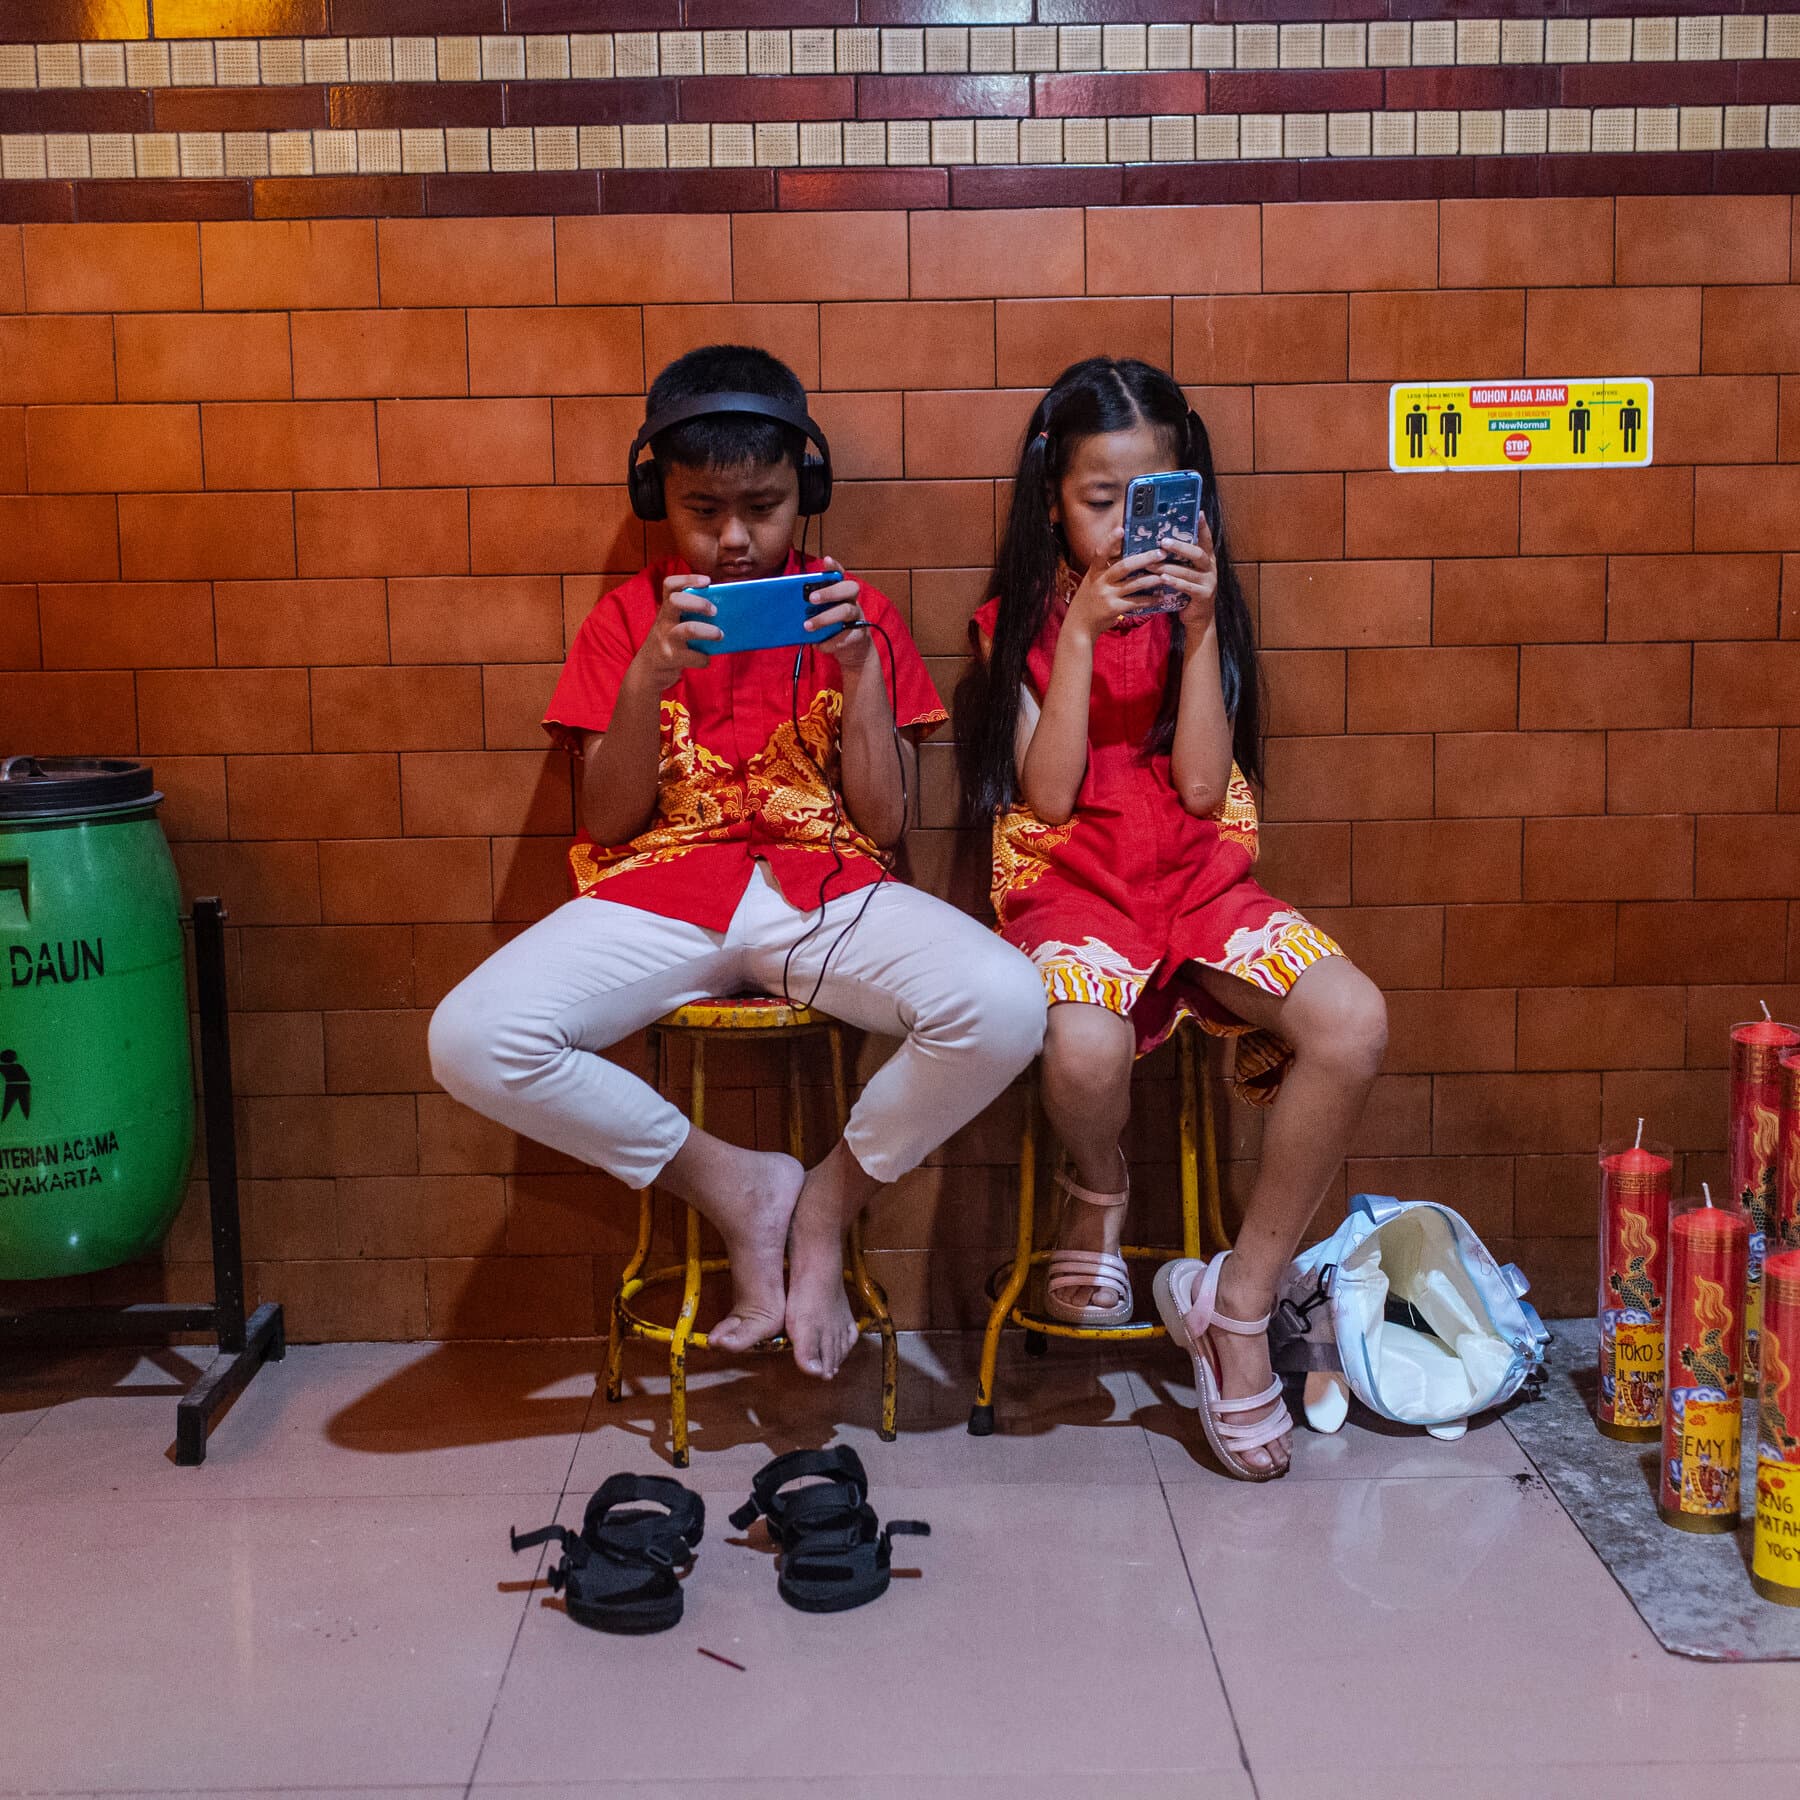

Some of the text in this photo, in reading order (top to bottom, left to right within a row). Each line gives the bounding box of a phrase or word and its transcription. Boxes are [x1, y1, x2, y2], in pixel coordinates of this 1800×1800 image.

[1472, 388, 1565, 404] MOHON JAGA JARAK
[1505, 439, 1530, 451] STOP
[10, 937, 105, 988] DAUN
[0, 1144, 59, 1169] TERIAN
[1617, 1343, 1653, 1361] TOKO
[1684, 1435, 1726, 1459] EMY
